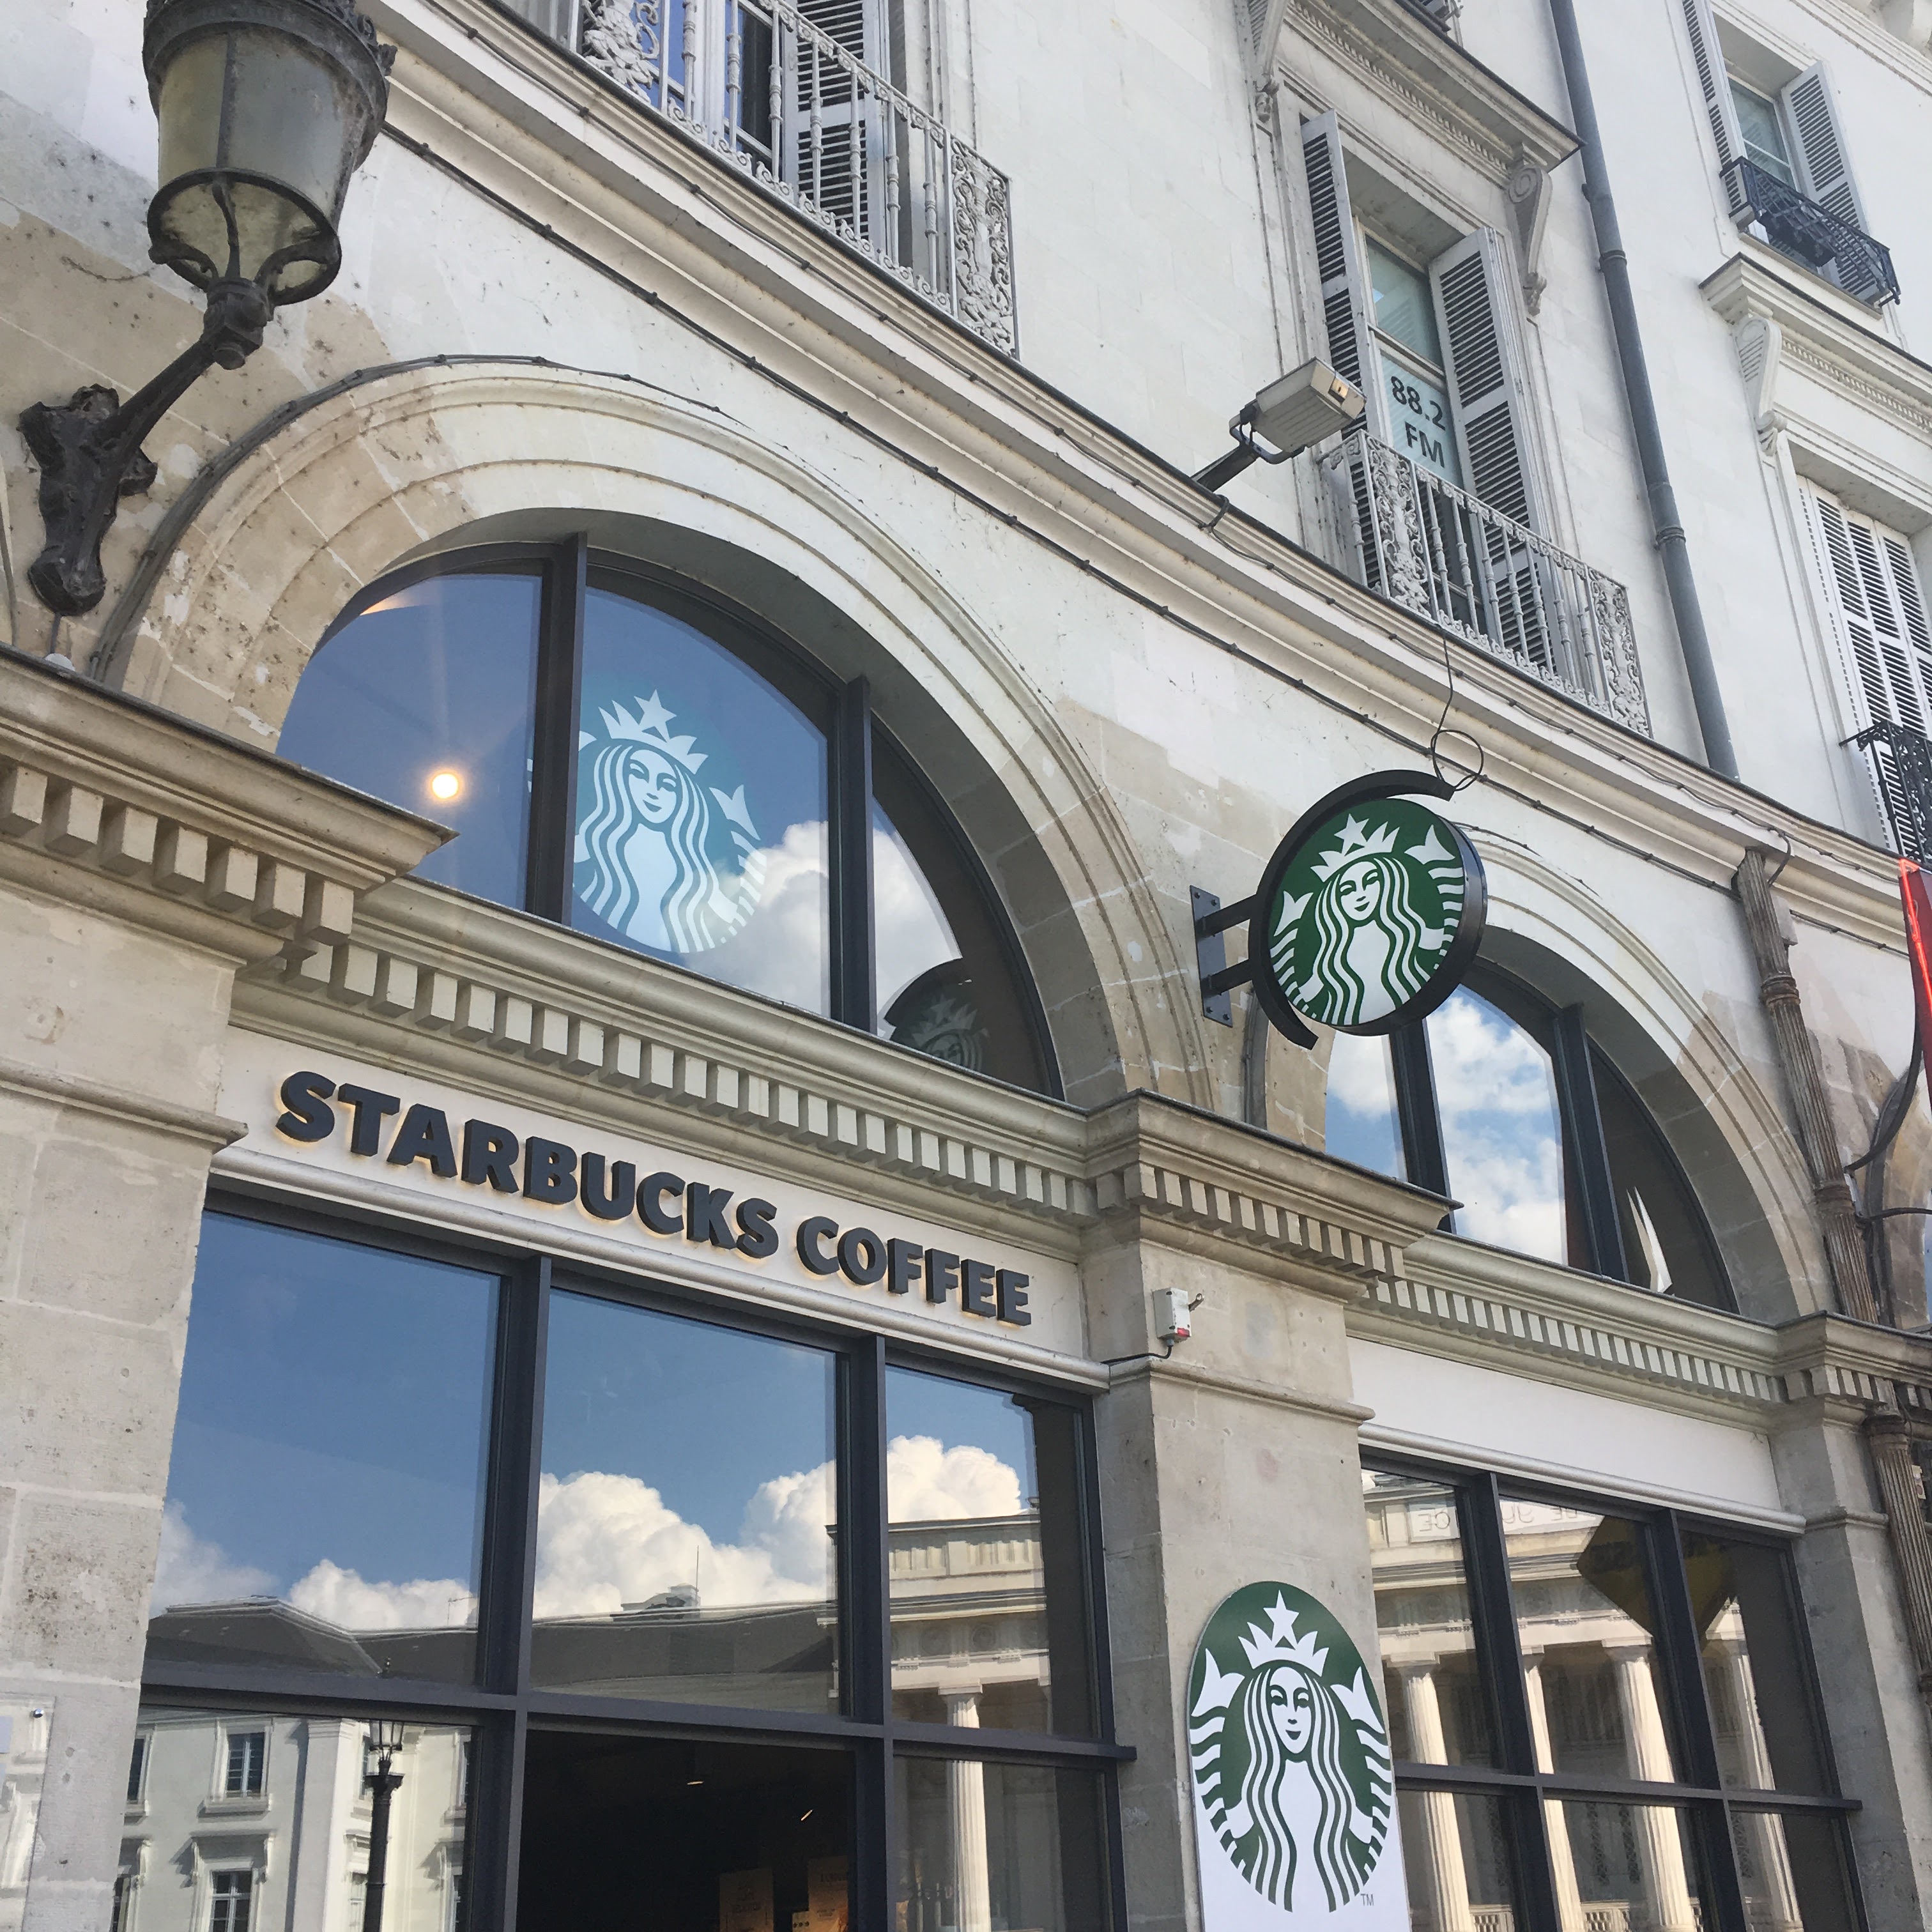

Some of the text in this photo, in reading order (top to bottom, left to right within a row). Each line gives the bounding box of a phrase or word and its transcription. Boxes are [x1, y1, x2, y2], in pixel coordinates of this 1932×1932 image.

[1391, 376, 1446, 431] 88.2
[1404, 420, 1445, 468] FM
[275, 1071, 1031, 1326] STARBUCKS COFFEE
[1360, 1893, 1374, 1906] TM
